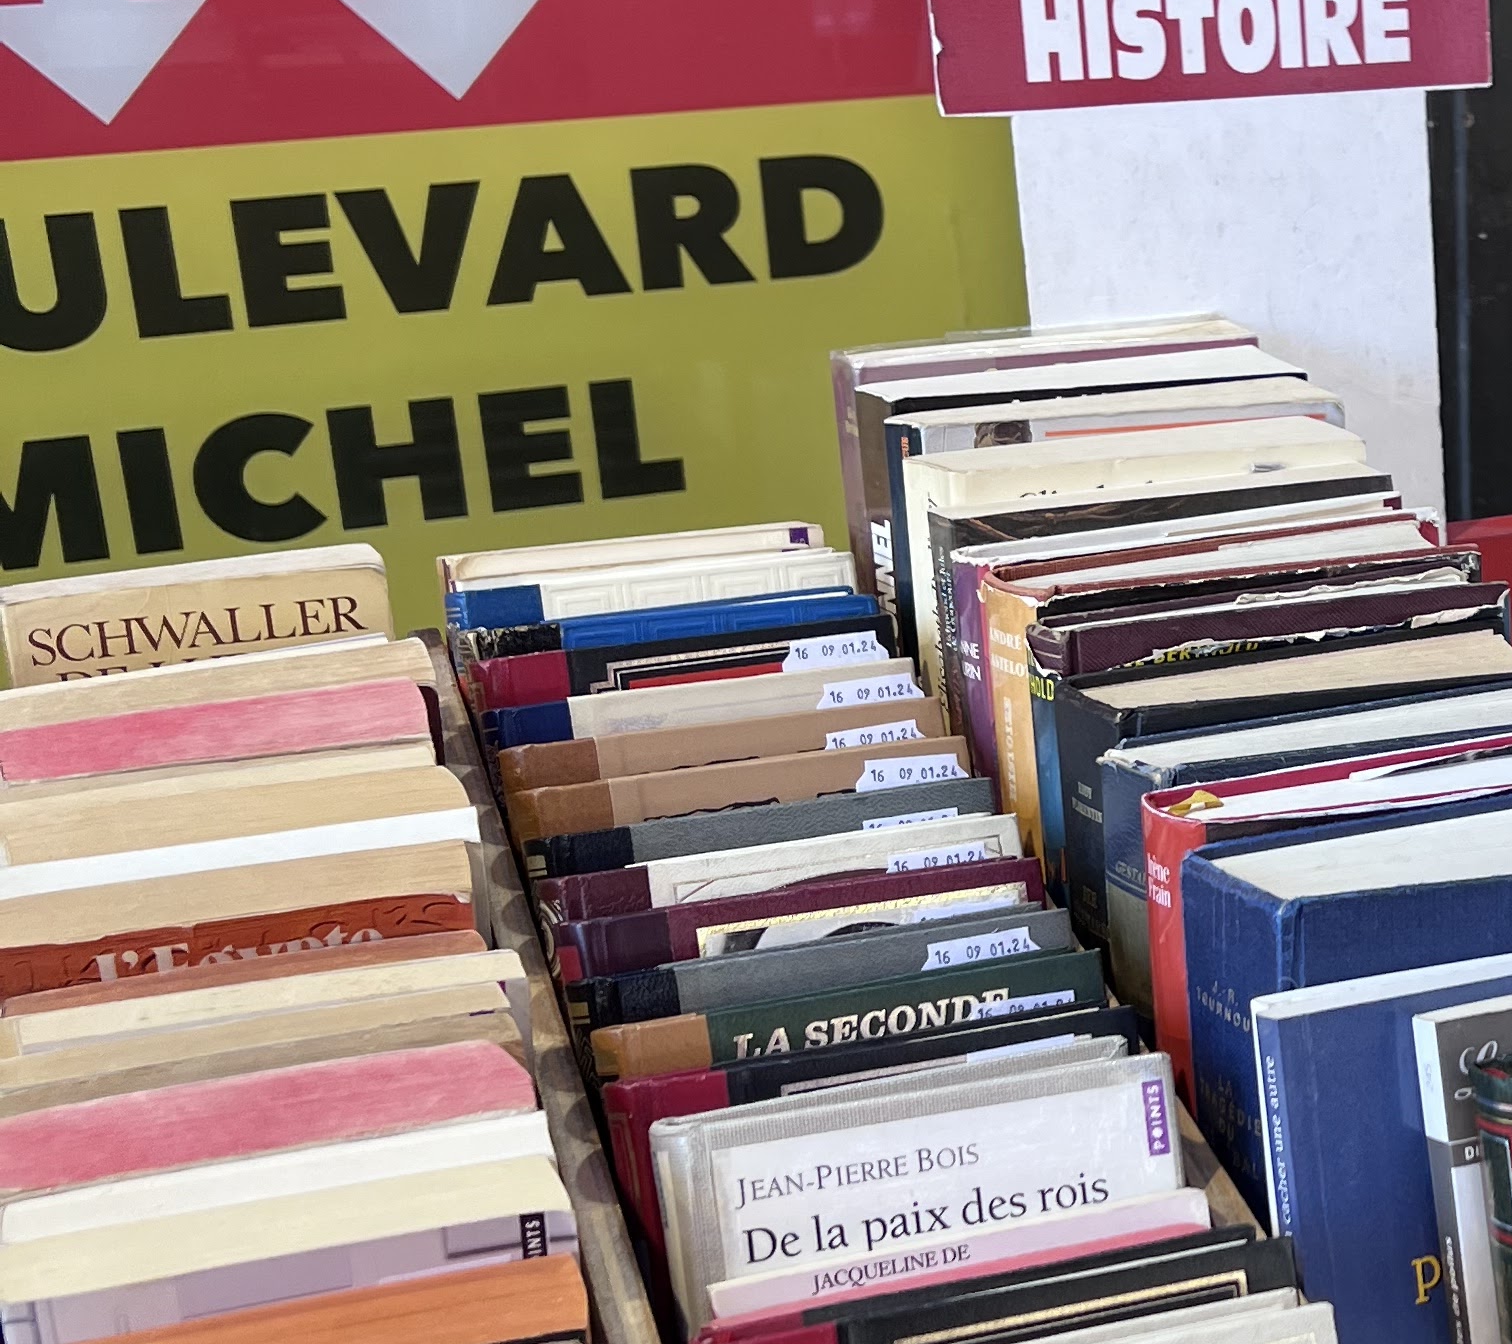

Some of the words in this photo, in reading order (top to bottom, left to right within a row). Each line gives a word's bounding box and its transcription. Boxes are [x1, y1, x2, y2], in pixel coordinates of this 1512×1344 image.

[0, 153, 883, 353] ULEVARD
[0, 377, 687, 570] MICHEL
[27, 596, 368, 666] SCHWALLER
[795, 647, 808, 660] 16
[821, 645, 834, 656] 09
[842, 640, 877, 655] 01.24
[935, 950, 951, 965] 16
[966, 946, 981, 959] 09
[990, 939, 1030, 956] 01.24
[732, 1027, 793, 1058] LA
[1265, 1055, 1282, 1108] autre
[1146, 1084, 1168, 1152] POINTS
[1273, 1113, 1285, 1153] une
[735, 1154, 909, 1210] JEAN-PIERRE
[916, 1143, 979, 1174] BOIS
[1277, 1157, 1292, 1224] cacher
[744, 1226, 801, 1265] De
[811, 1214, 848, 1253] la
[862, 1200, 951, 1251] paix
[962, 1187, 1027, 1226] des
[1039, 1172, 1110, 1212] rois
[811, 1252, 937, 1296] JACQUELINE
[941, 1244, 971, 1263] DE
